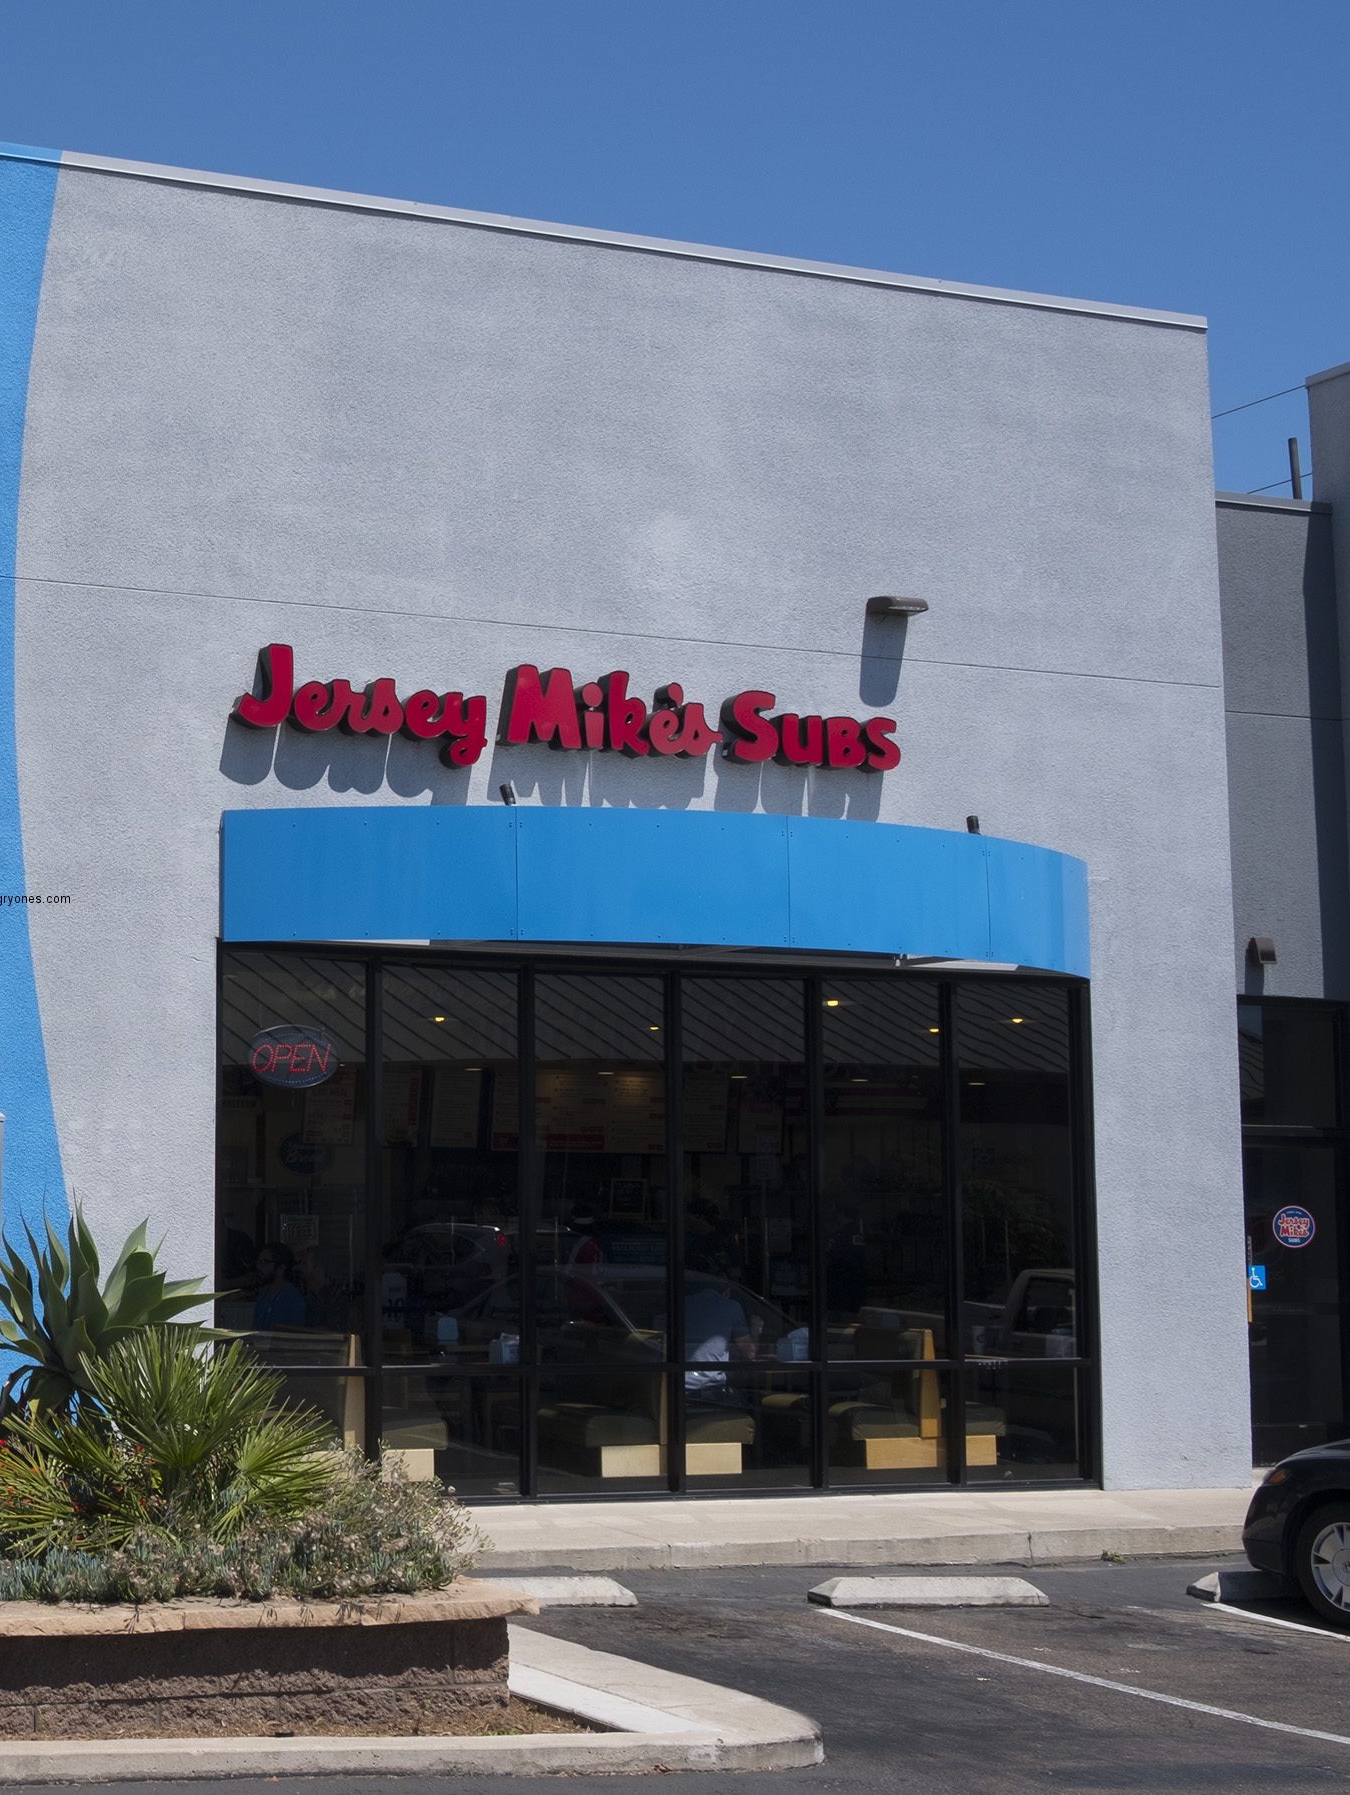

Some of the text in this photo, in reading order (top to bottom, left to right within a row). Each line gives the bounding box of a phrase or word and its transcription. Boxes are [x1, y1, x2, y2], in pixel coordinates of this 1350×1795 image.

[232, 643, 487, 766] Jersey
[500, 664, 724, 758] Mike's
[251, 1043, 331, 1073] OPEN
[1278, 1214, 1309, 1230] Jersey
